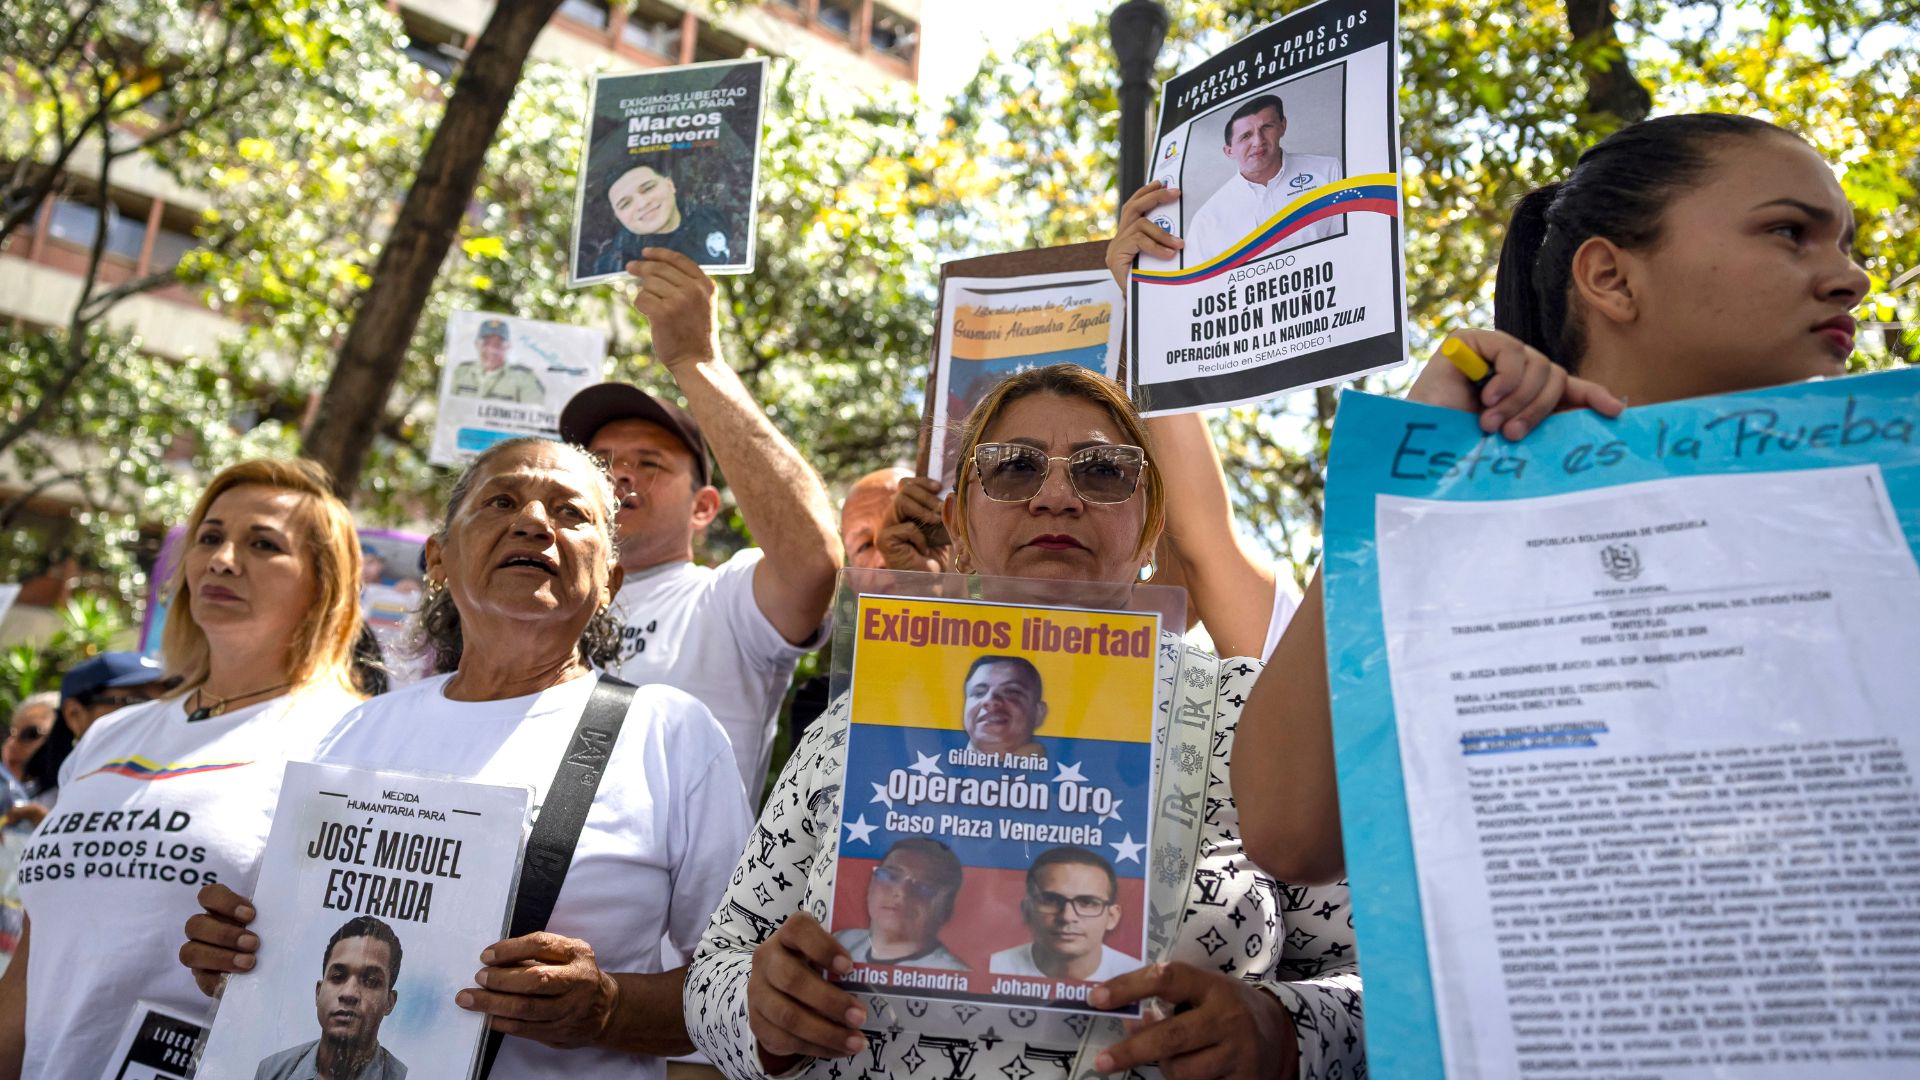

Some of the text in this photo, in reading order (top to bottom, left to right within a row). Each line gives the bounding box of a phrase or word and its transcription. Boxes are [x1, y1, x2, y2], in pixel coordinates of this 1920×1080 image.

[1177, 9, 1368, 108] LIBERTAD A TODOS LOS
[1192, 33, 1350, 111] PRESOS POLÍTICOS
[619, 86, 747, 109] EXIGIMOS LIBERTAD
[625, 97, 736, 117] INMEDIATA PARA
[627, 126, 720, 148] Echeverri
[628, 112, 722, 133] Marcos
[1227, 255, 1296, 285] ABOGADO
[1192, 260, 1334, 318] JOSÉ GREGORIO
[1190, 286, 1337, 342] RONDÓN MUÑOZ
[1004, 317, 1064, 341] Alexandra
[1166, 306, 1366, 365] OPERACIÓN NO A LA NAVIDAD ZULIA
[1197, 334, 1332, 373] Recluido en SEMAS RODEO 1
[1389, 394, 1916, 480] Esta es la Prueba
[863, 608, 1151, 658] Exigimos libertad
[948, 748, 1048, 771] Gilbert Araña
[382, 789, 420, 803] MEDIDA
[887, 768, 1113, 815] Operación Oro
[39, 808, 191, 837] LIBERTAD
[347, 799, 446, 822] HUMANITARIA PARA
[885, 810, 1103, 846] Caso Plaza Venezuela
[72, 840, 147, 857] TODOS
[155, 841, 206, 863] LOS
[307, 817, 463, 879] JOSÉ MIGUEL
[18, 858, 218, 887] RESOS POLÍTICOS
[322, 868, 434, 923] ESTRADA
[892, 969, 969, 992] Belandria
[991, 977, 1093, 1000] Johany Rodr
[153, 1026, 201, 1052] LIBERT
